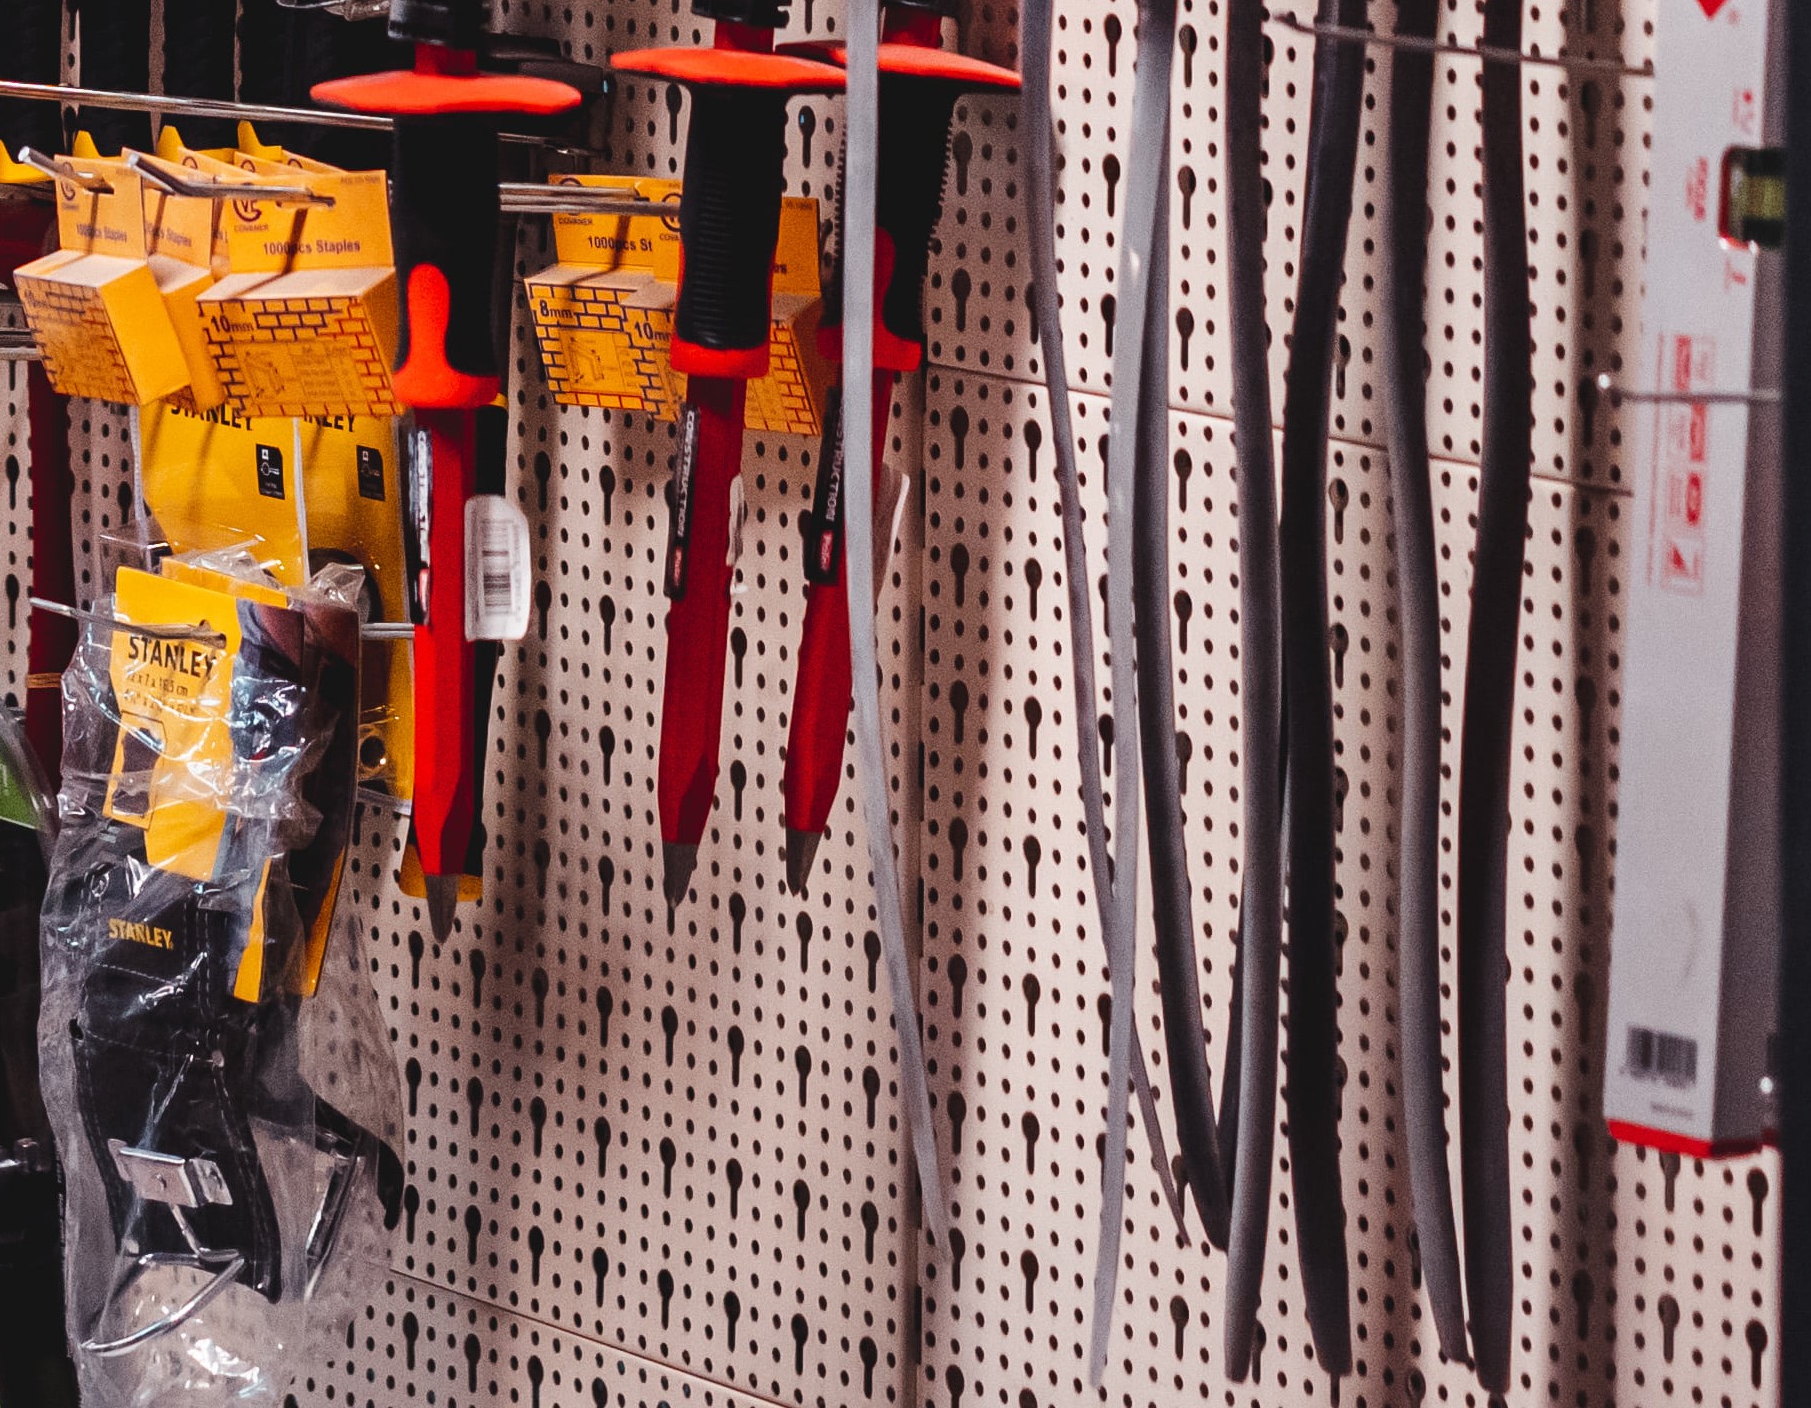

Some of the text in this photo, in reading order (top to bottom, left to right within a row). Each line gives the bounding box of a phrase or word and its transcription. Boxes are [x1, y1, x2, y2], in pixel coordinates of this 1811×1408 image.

[315, 239, 361, 257] Staples
[539, 299, 583, 321] 8mm
[210, 314, 254, 336] 10mm
[127, 635, 217, 680] STANLEY
[108, 917, 174, 950] STANLEY
